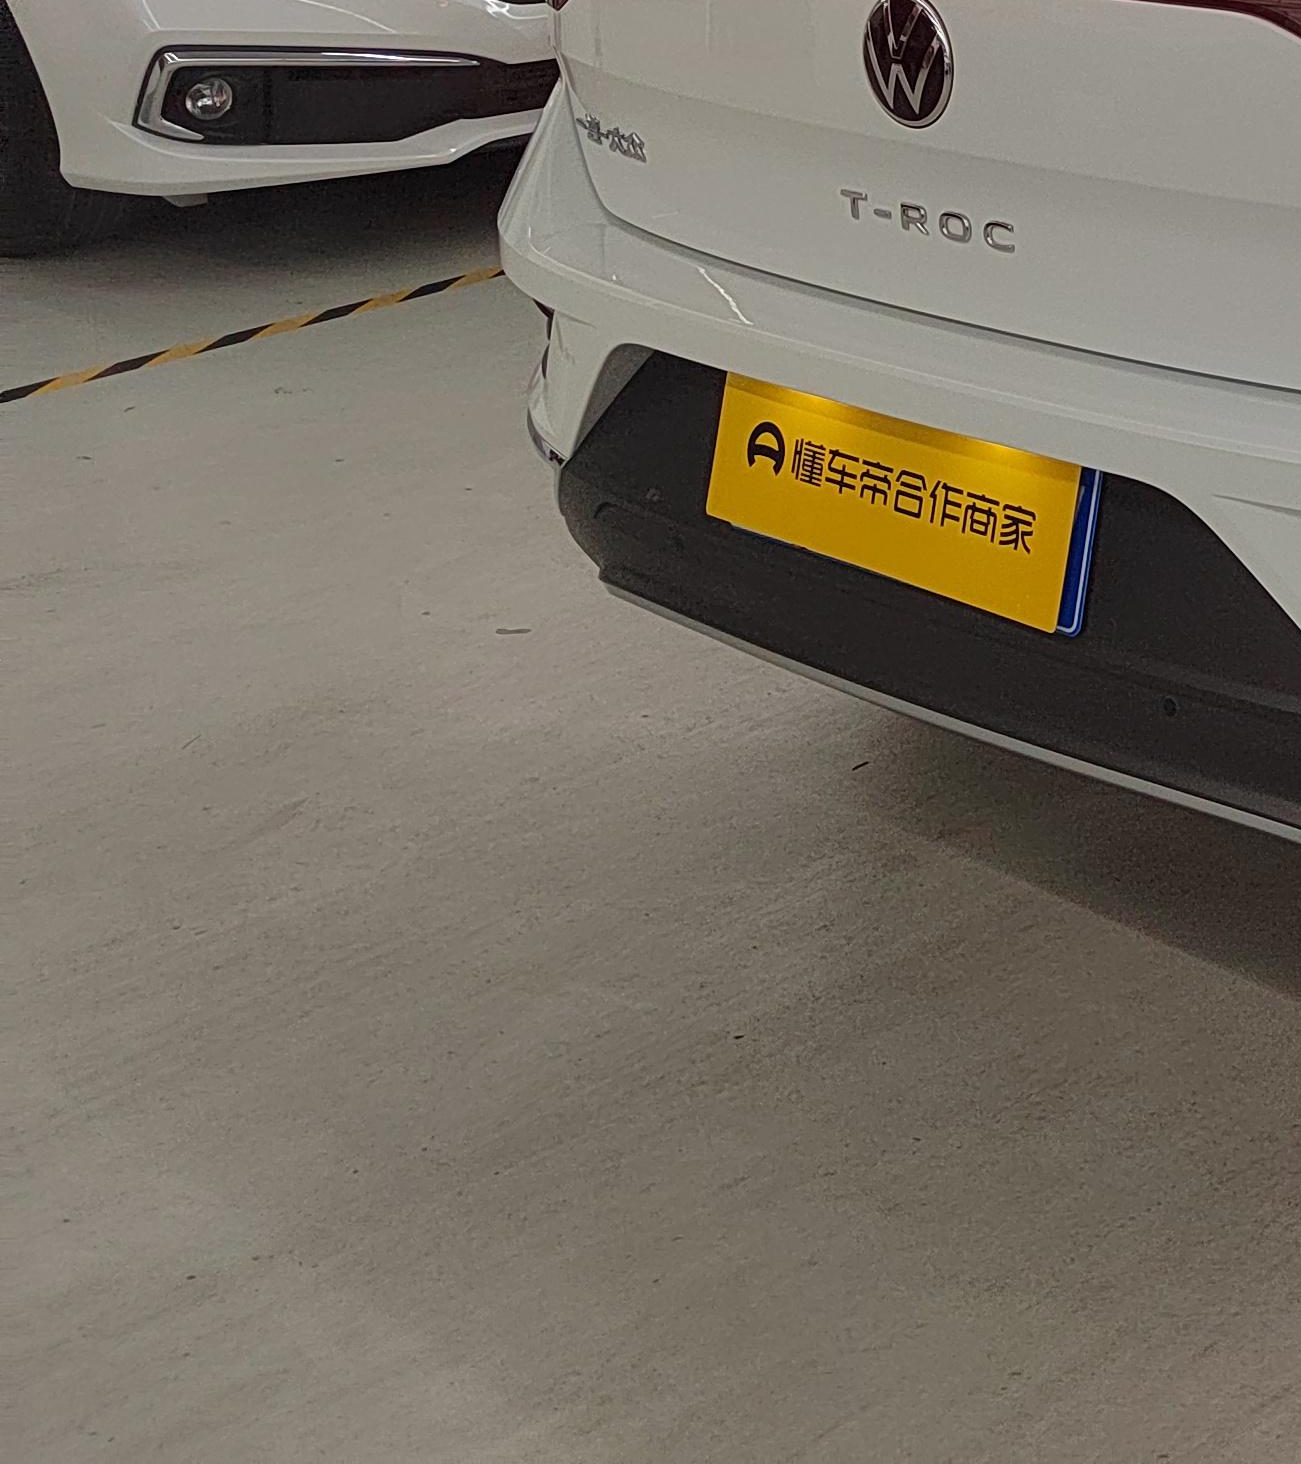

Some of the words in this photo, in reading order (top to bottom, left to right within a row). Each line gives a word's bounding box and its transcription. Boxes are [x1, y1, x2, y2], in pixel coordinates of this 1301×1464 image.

[839, 187, 1016, 254] T-ROC
[789, 437, 1038, 555] 懂车帝合作商家
